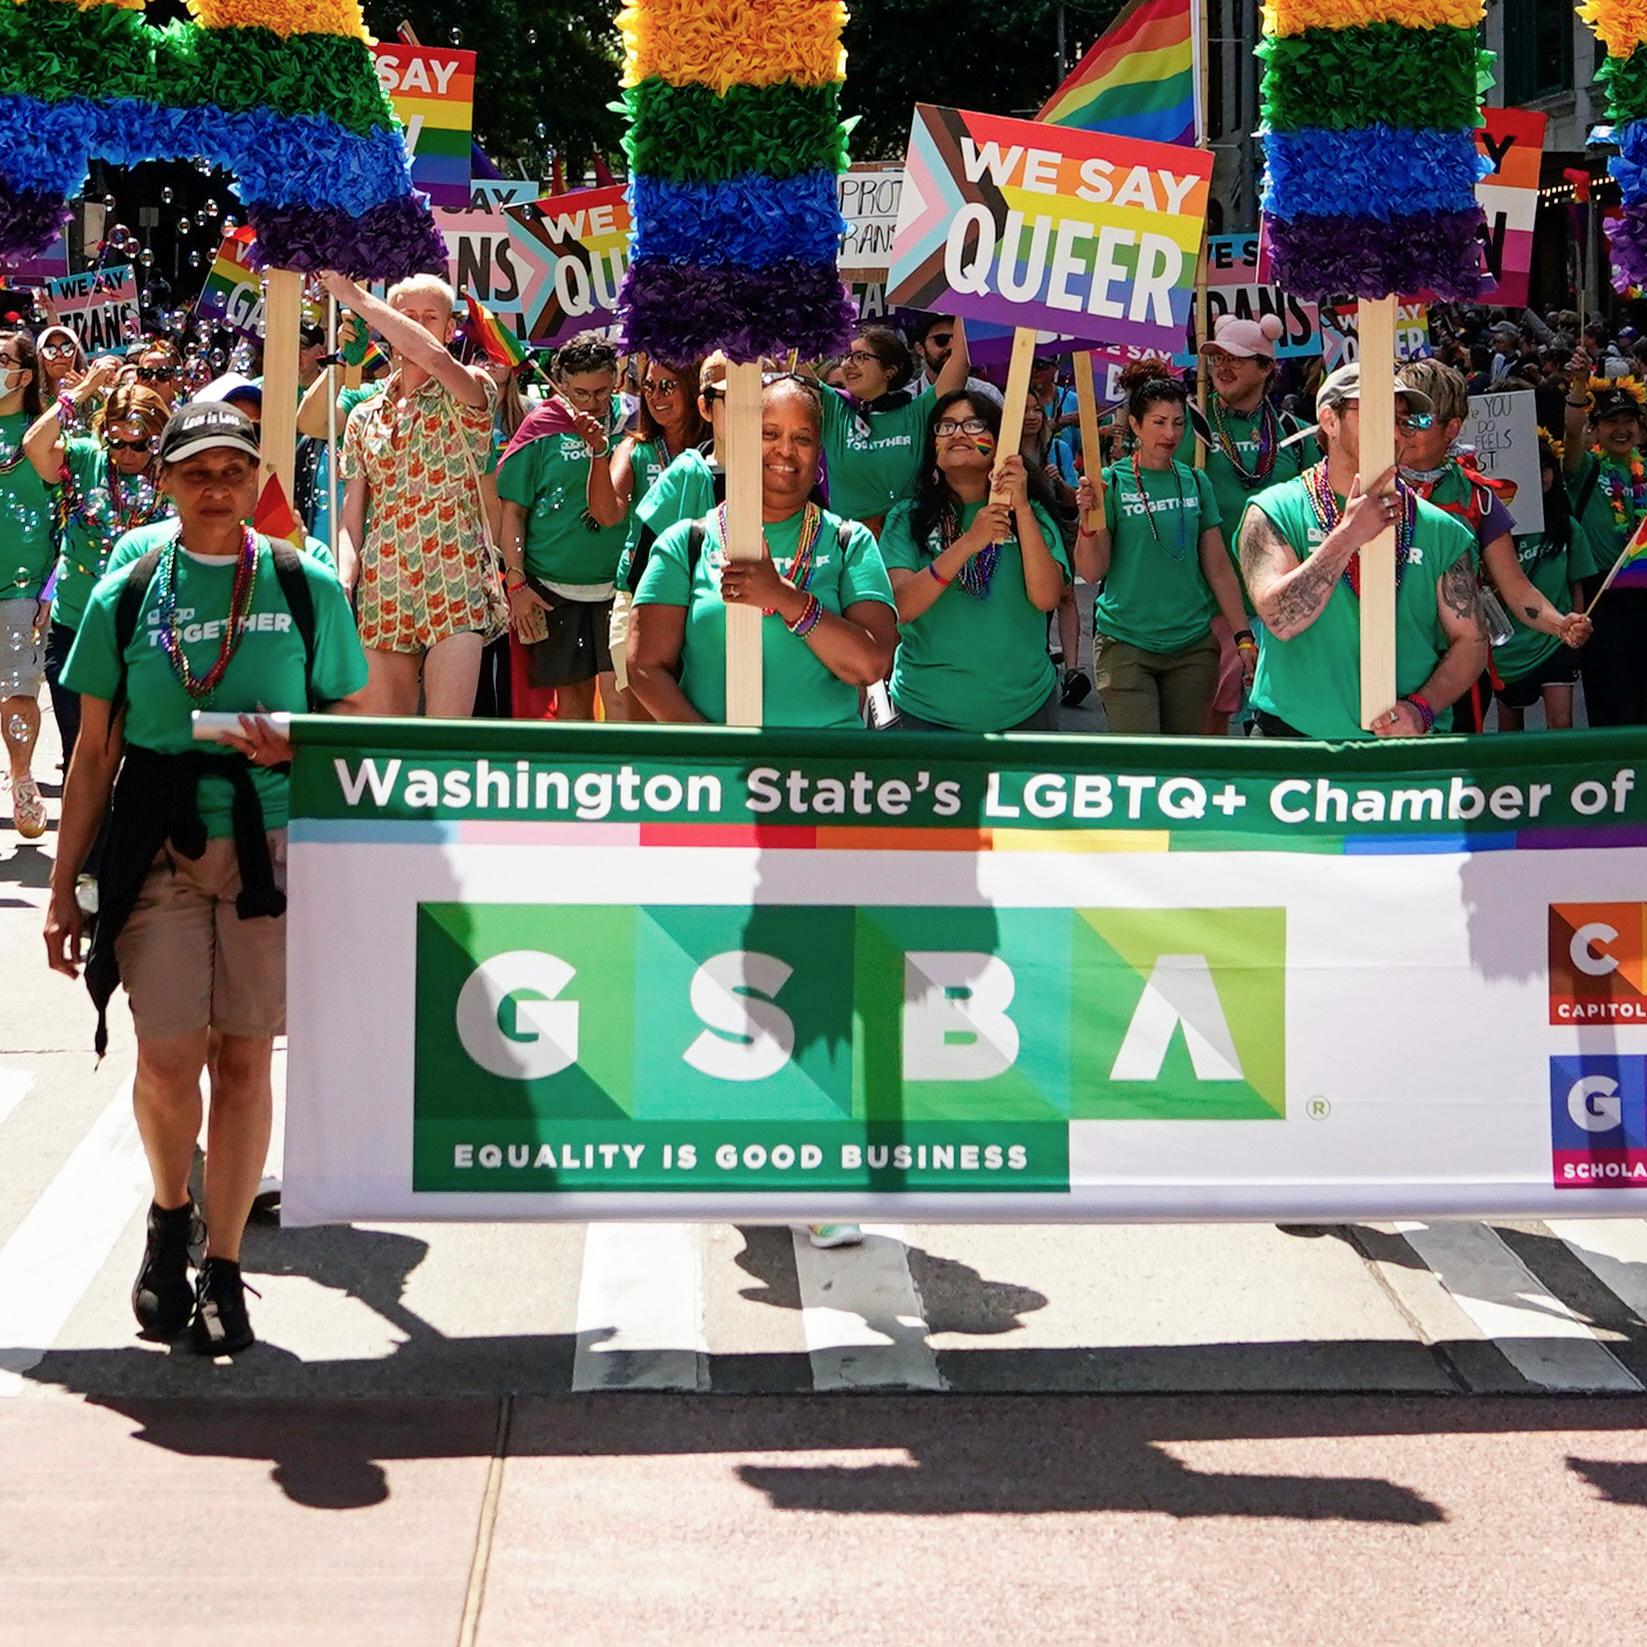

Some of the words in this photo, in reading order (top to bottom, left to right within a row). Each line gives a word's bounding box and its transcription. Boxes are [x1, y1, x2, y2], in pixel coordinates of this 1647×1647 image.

[375, 55, 459, 95] SAY
[960, 136, 1063, 196] WE
[1075, 158, 1201, 216] SAY
[442, 188, 518, 216] AY
[840, 179, 903, 216] PROT
[541, 205, 615, 245] WE
[944, 203, 1183, 328] QUEER
[1208, 241, 1233, 269] E
[60, 278, 88, 301] WE
[226, 281, 267, 337] GA
[1396, 303, 1420, 320] AY
[1343, 327, 1425, 363] QER
[1483, 394, 1512, 419] YOU
[334, 758, 722, 820] Washington
[745, 768, 962, 815] State’s
[986, 771, 1246, 820] LGBTQ+
[1270, 776, 1552, 825] Chamber
[1572, 770, 1635, 816] of
[455, 949, 1246, 1082] GSBA
[1557, 1002, 1647, 1019] CAPITOL
[453, 1143, 646, 1171] EQUALITY
[662, 1143, 699, 1170] IS
[713, 1143, 823, 1170] GOOD
[841, 1144, 1029, 1170] BUSINESS
